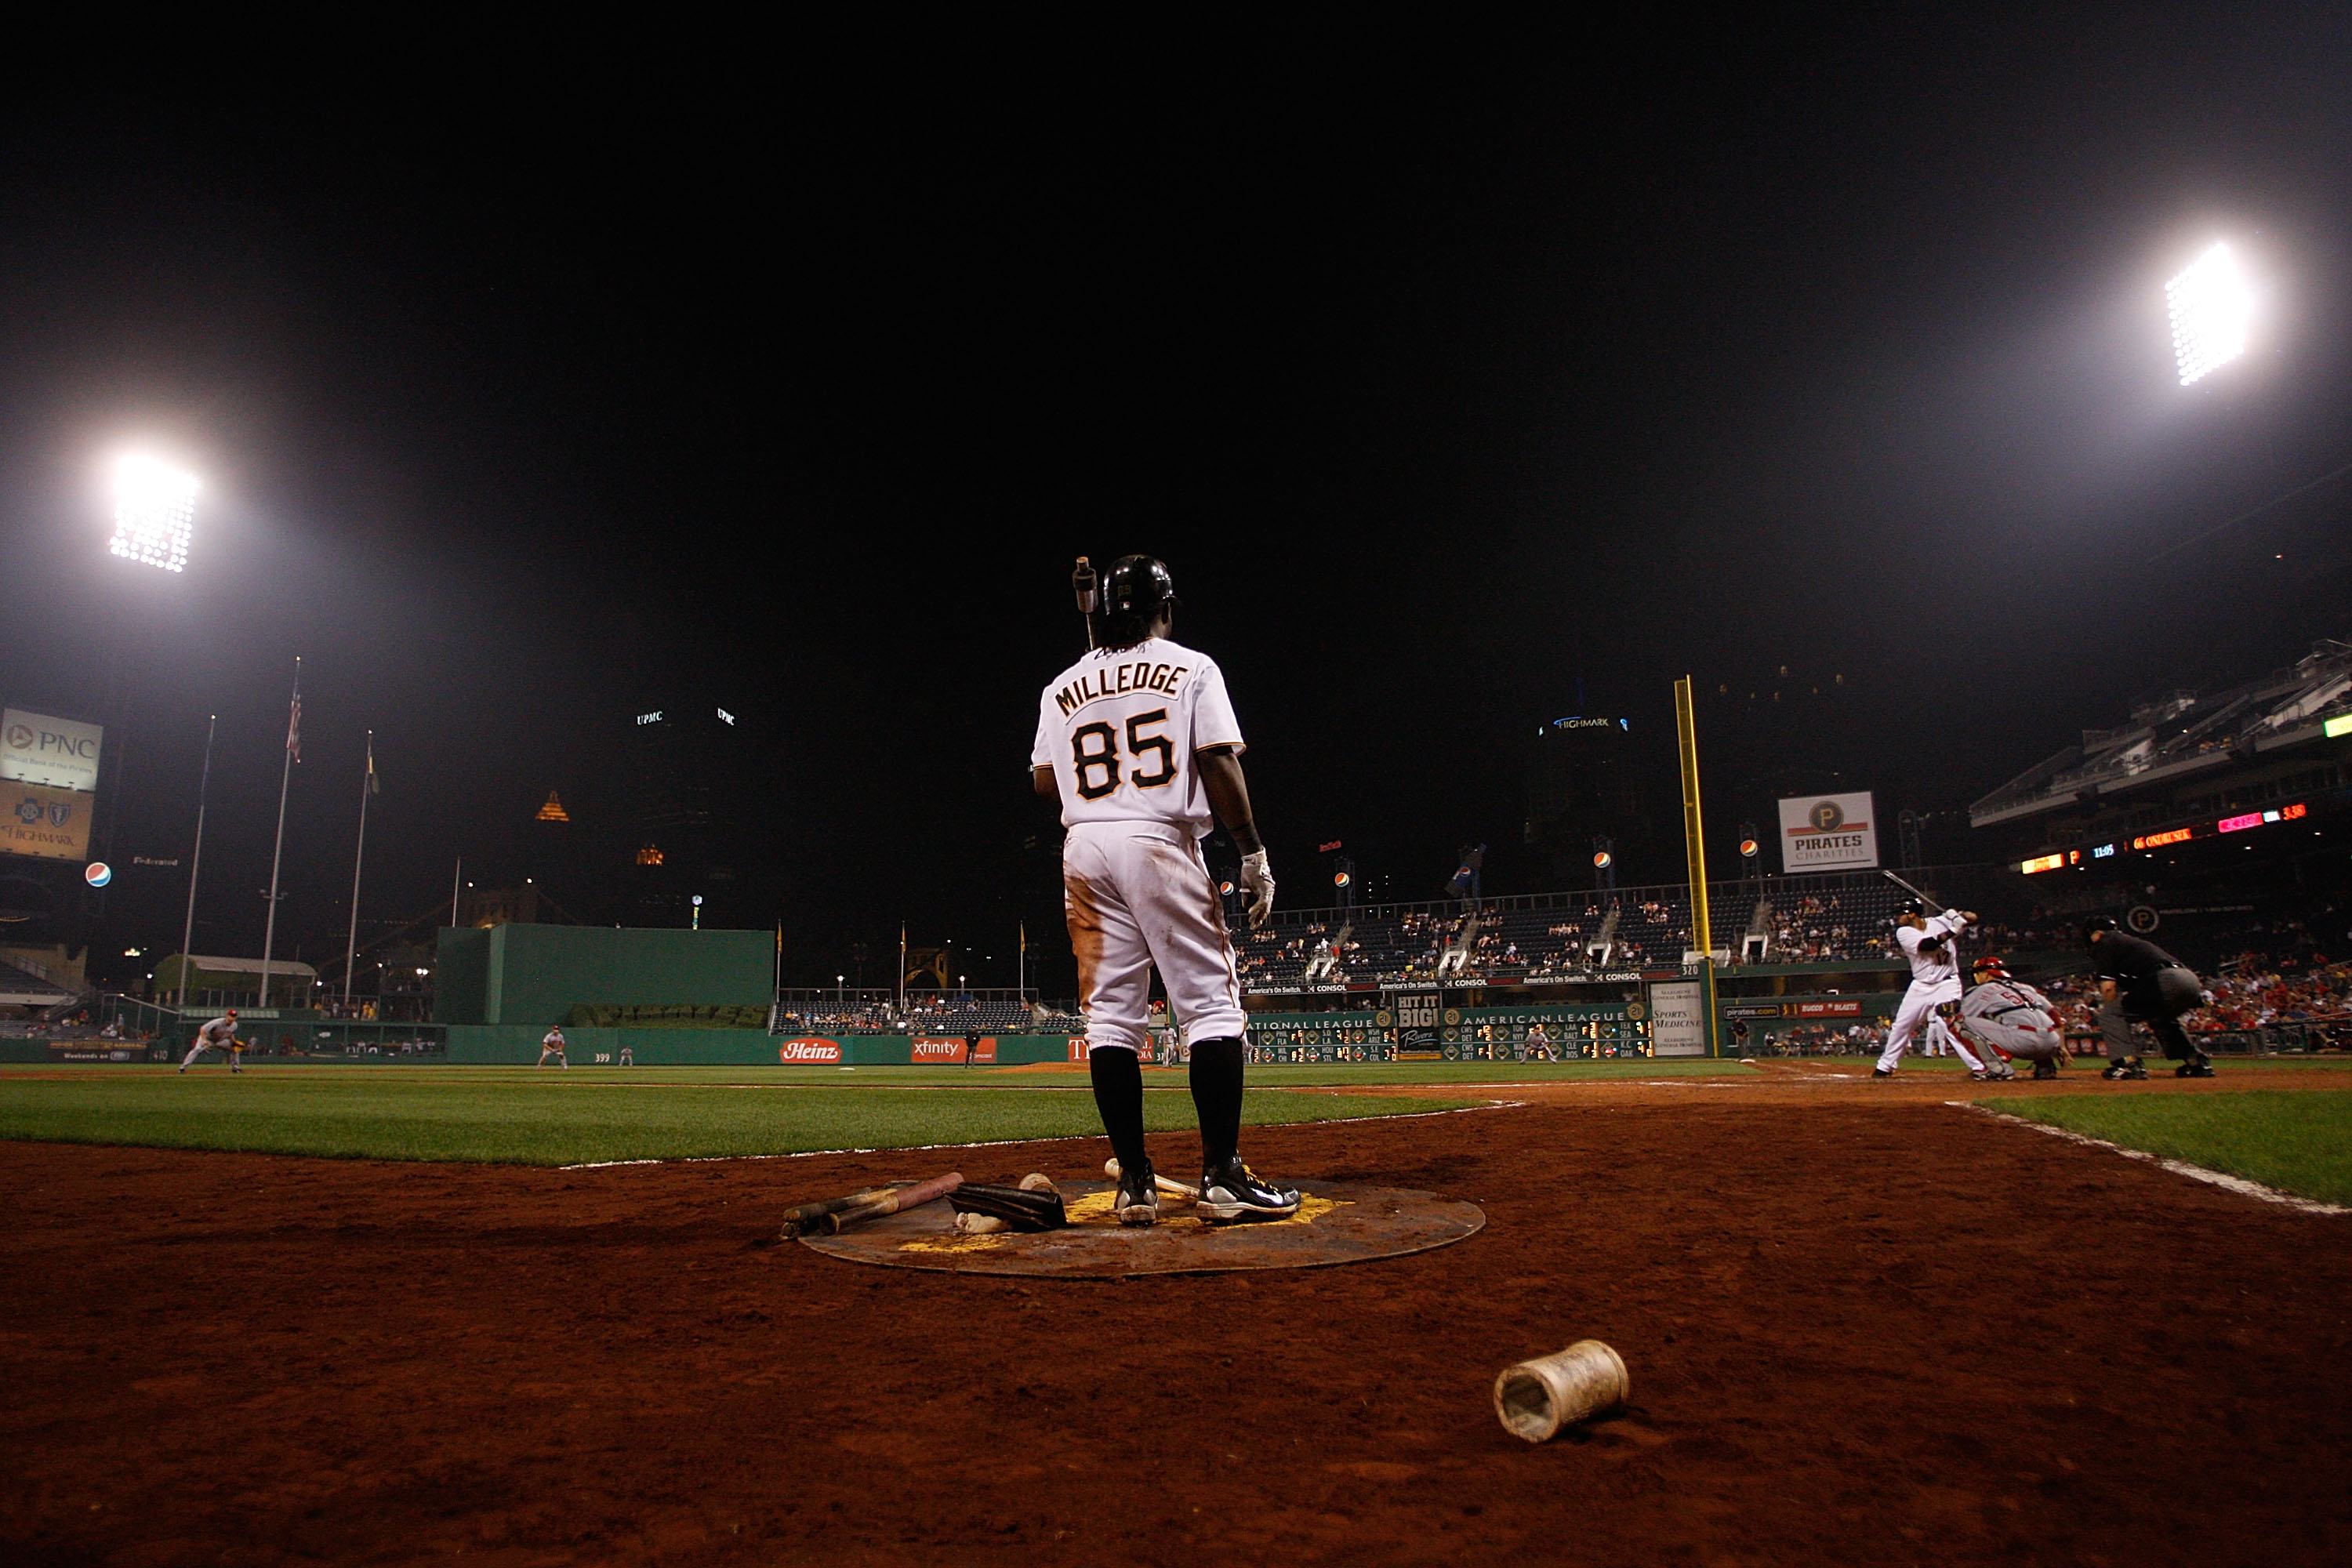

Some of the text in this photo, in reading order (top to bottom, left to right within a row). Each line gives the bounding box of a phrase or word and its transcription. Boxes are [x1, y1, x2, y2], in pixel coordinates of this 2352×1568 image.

[1054, 662, 1189, 717] MILLEDGE
[637, 710, 663, 725] UPMC
[717, 707, 735, 725] UPMC
[1558, 717, 1610, 730] HIGHMARK
[39, 731, 95, 760] PNC
[1071, 707, 1178, 803] 85
[1820, 808, 1834, 828] P
[7, 827, 75, 848] HIGHMARK
[1795, 835, 1862, 851] PIRATES
[2133, 837, 2145, 850] 66
[1795, 848, 1864, 861] CHARITIES
[2093, 843, 2114, 858] 11:05
[2070, 850, 2080, 865] P
[1606, 972, 1642, 981] CONSOL
[1682, 965, 1699, 975] 320
[1398, 995, 1438, 1008] HIT IT
[1447, 1012, 1456, 1022] 21
[1631, 1007, 1639, 1015] 21
[1653, 1011, 1687, 1019] SPORTS
[1726, 1008, 1777, 1017] pirates.com
[1246, 1019, 1373, 1030] ATIONAL LEAGUE
[1380, 1014, 1387, 1024] 21
[1398, 1008, 1439, 1028] BIG!
[1464, 1012, 1624, 1025] AMERICAN LEAGUE
[1654, 1019, 1701, 1029] MEDICINE
[1582, 1026, 1587, 1035] F
[783, 1042, 840, 1059] Heinz
[914, 1040, 959, 1056] xfinity
[1592, 1049, 1597, 1058] 3
[595, 1053, 610, 1062] 399
